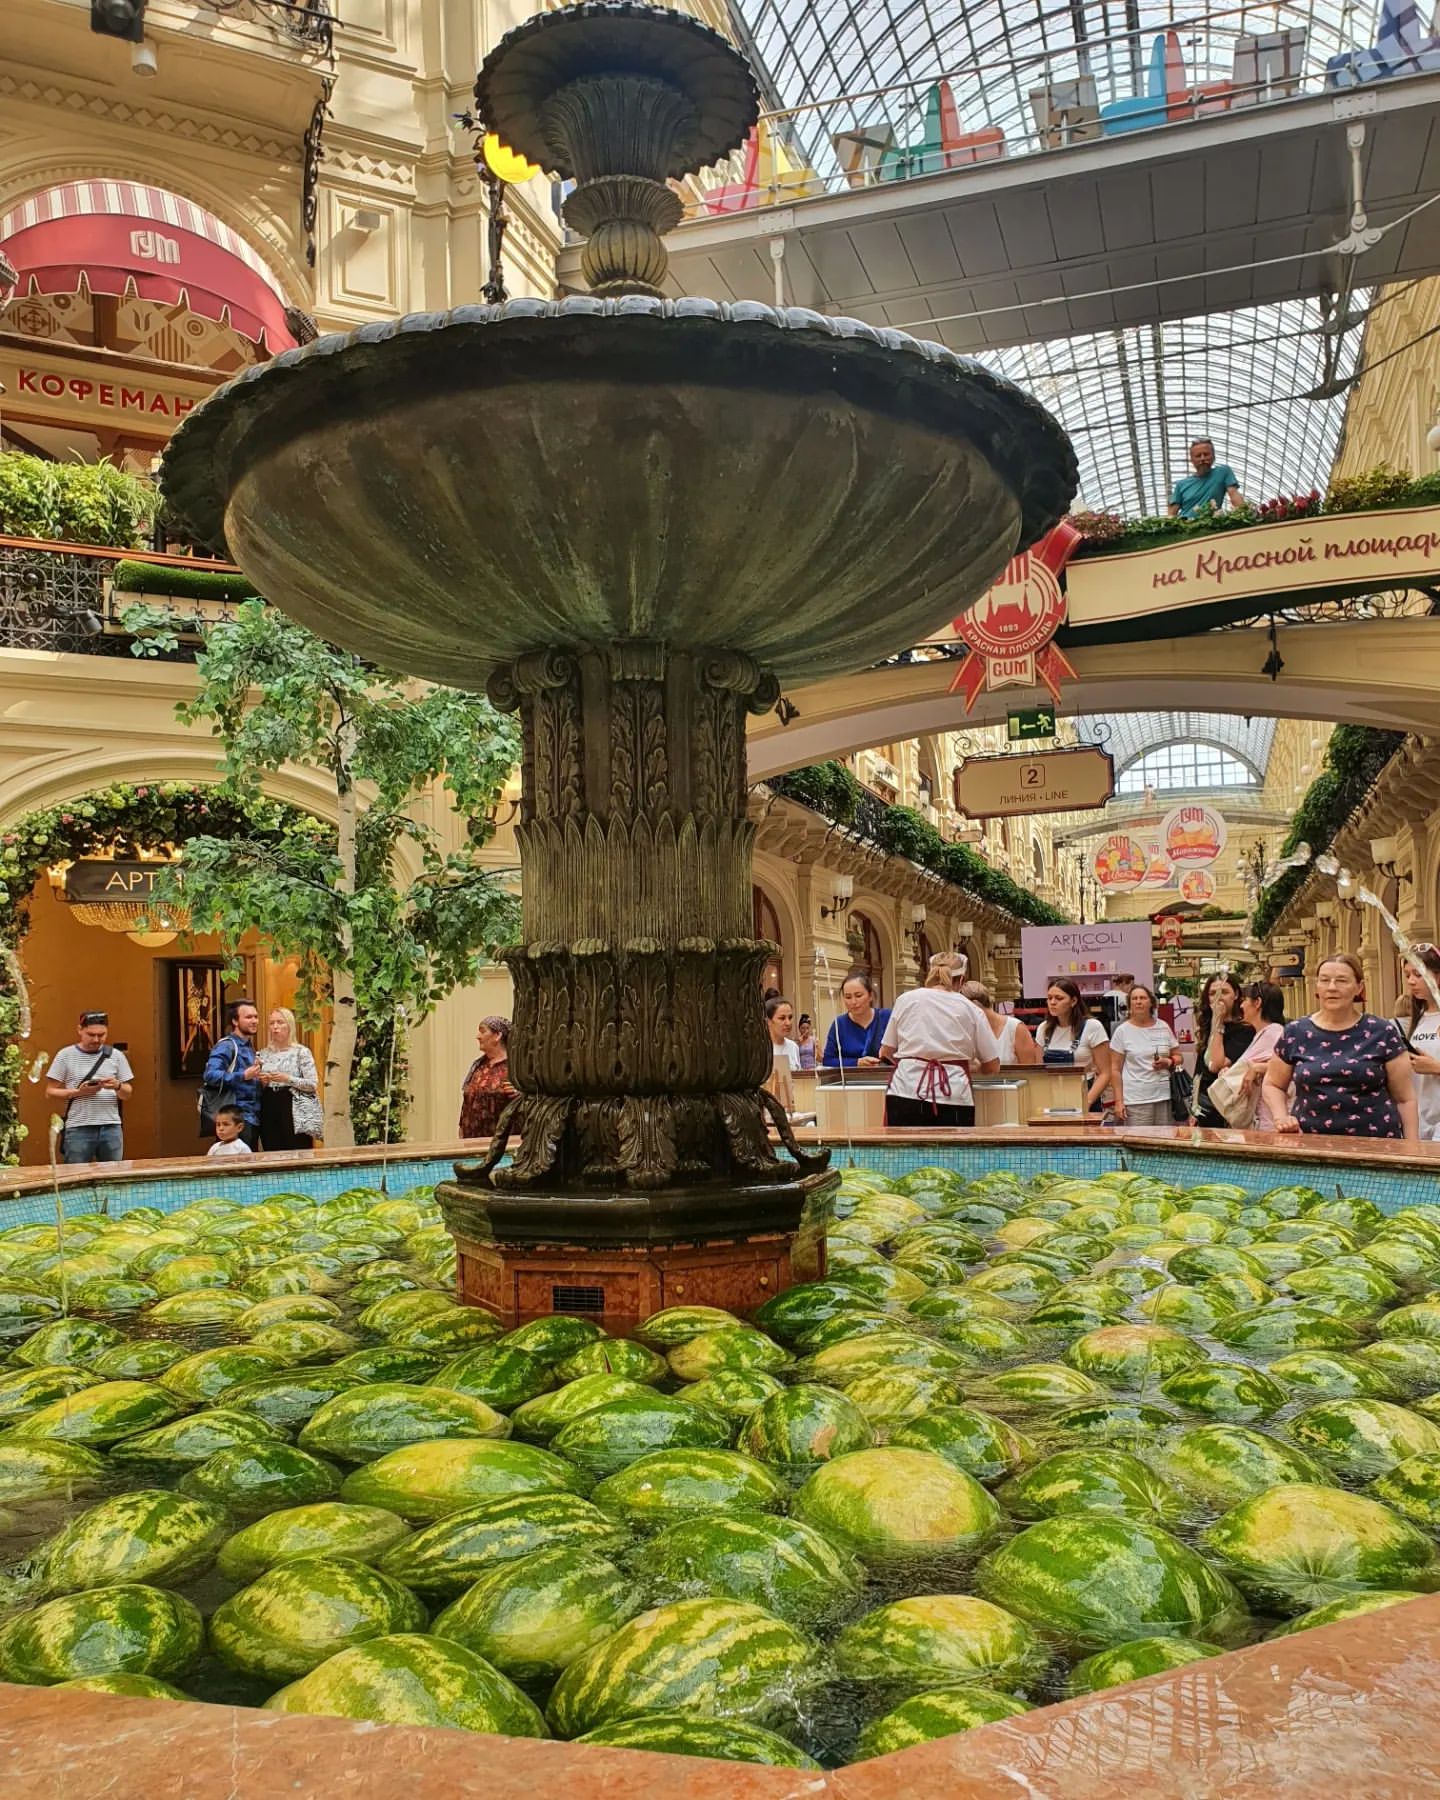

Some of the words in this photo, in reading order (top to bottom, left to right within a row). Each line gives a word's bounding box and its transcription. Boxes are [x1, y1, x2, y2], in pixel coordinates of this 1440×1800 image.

[18, 369, 195, 417] КОФЕМАН
[1152, 568, 1186, 589] на
[1195, 537, 1315, 584] Красной
[966, 628, 1008, 655] КРАСНАЯ
[1009, 620, 1053, 655] ПЛОЩАДЬ
[992, 659, 1028, 677] GUM
[1027, 769, 1039, 784] 2
[1000, 793, 1037, 805] ЛИНИЯ
[1045, 790, 1069, 801] LINE
[105, 871, 179, 892] АРТ
[1050, 931, 1124, 946] ARTICOLI
